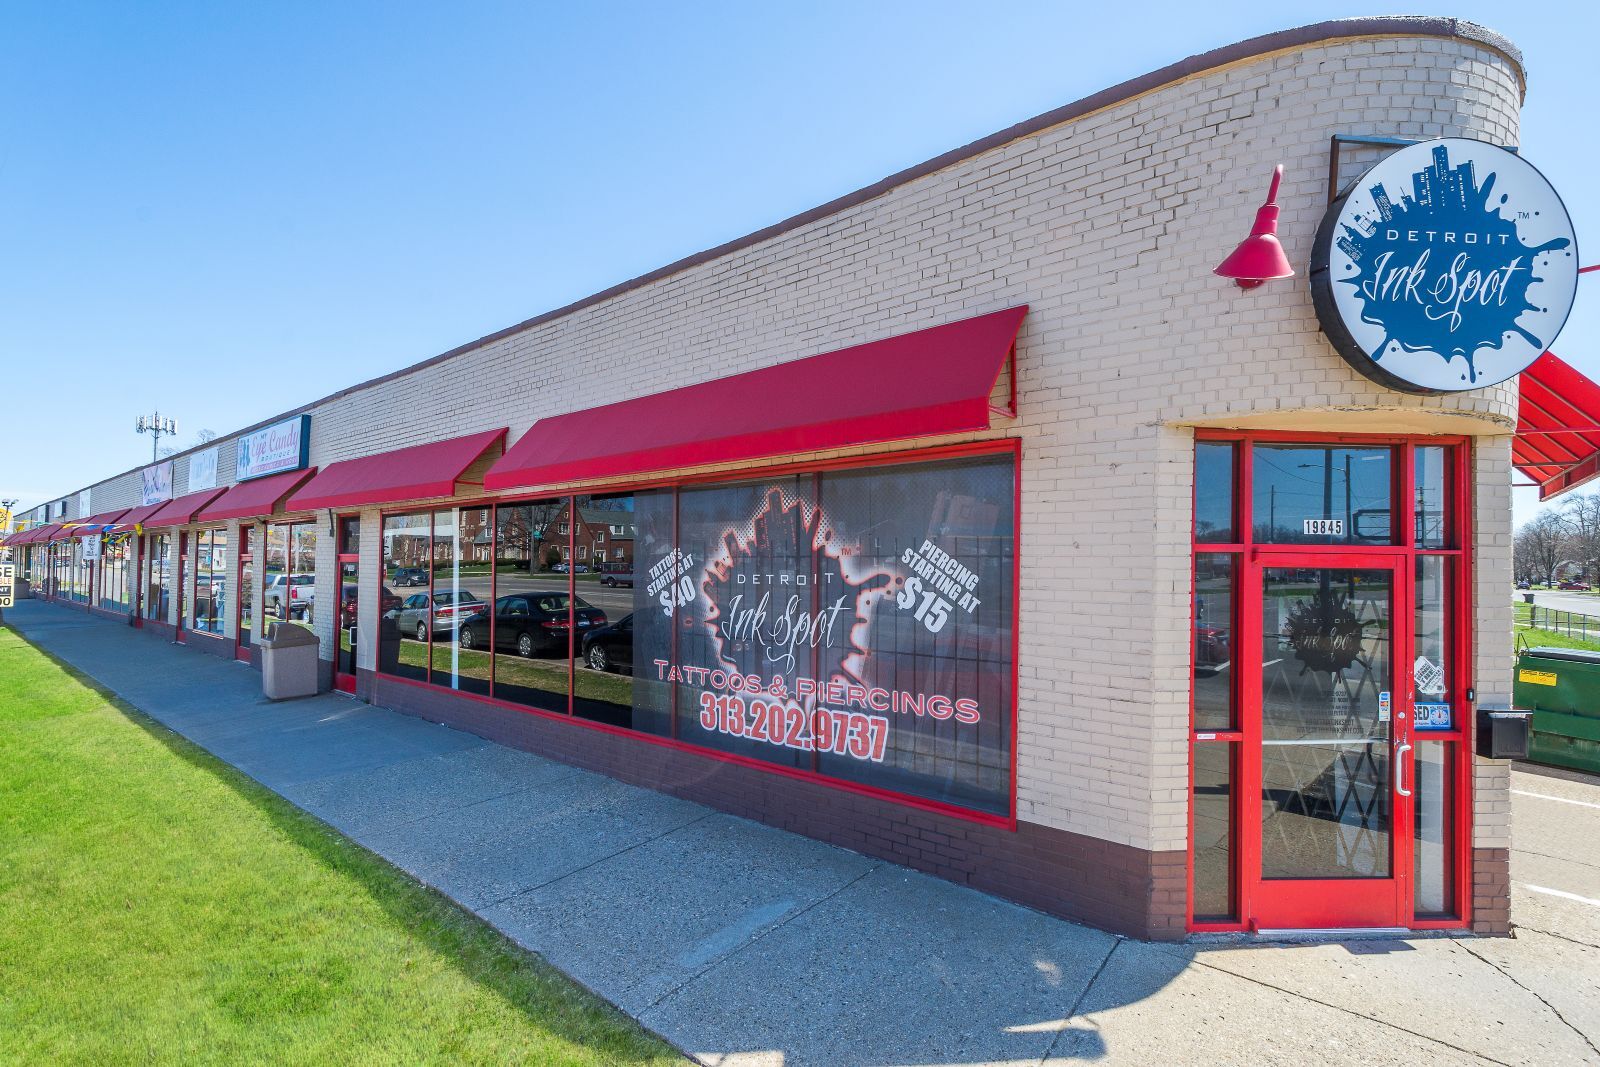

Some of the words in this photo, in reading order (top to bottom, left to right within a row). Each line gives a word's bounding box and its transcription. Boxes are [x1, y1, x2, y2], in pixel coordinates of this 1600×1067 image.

[1386, 229, 1510, 245] DETROIT
[1517, 211, 1530, 220] TM
[1362, 248, 1431, 305] Ink
[1425, 252, 1527, 333] Spot
[251, 434, 267, 464] Eye
[270, 424, 298, 454] Candy
[261, 450, 290, 461] BOUTIQUE
[1305, 521, 1343, 534] 19845
[646, 562, 685, 597] STARTING
[682, 553, 694, 571] AT
[648, 547, 684, 581] TATTOOS
[736, 572, 835, 586] DETROIT
[901, 547, 962, 602] STARTING
[957, 591, 982, 614] AT
[918, 539, 980, 592] PIERCING
[659, 575, 696, 618] $40
[896, 576, 954, 633] $15
[720, 594, 767, 646] Ink
[766, 594, 852, 676] Spot
[654, 659, 762, 695] TATTOOS
[768, 674, 788, 700] &
[795, 677, 981, 725] PIERCINGS
[701, 692, 889, 763] 313.202.9737
